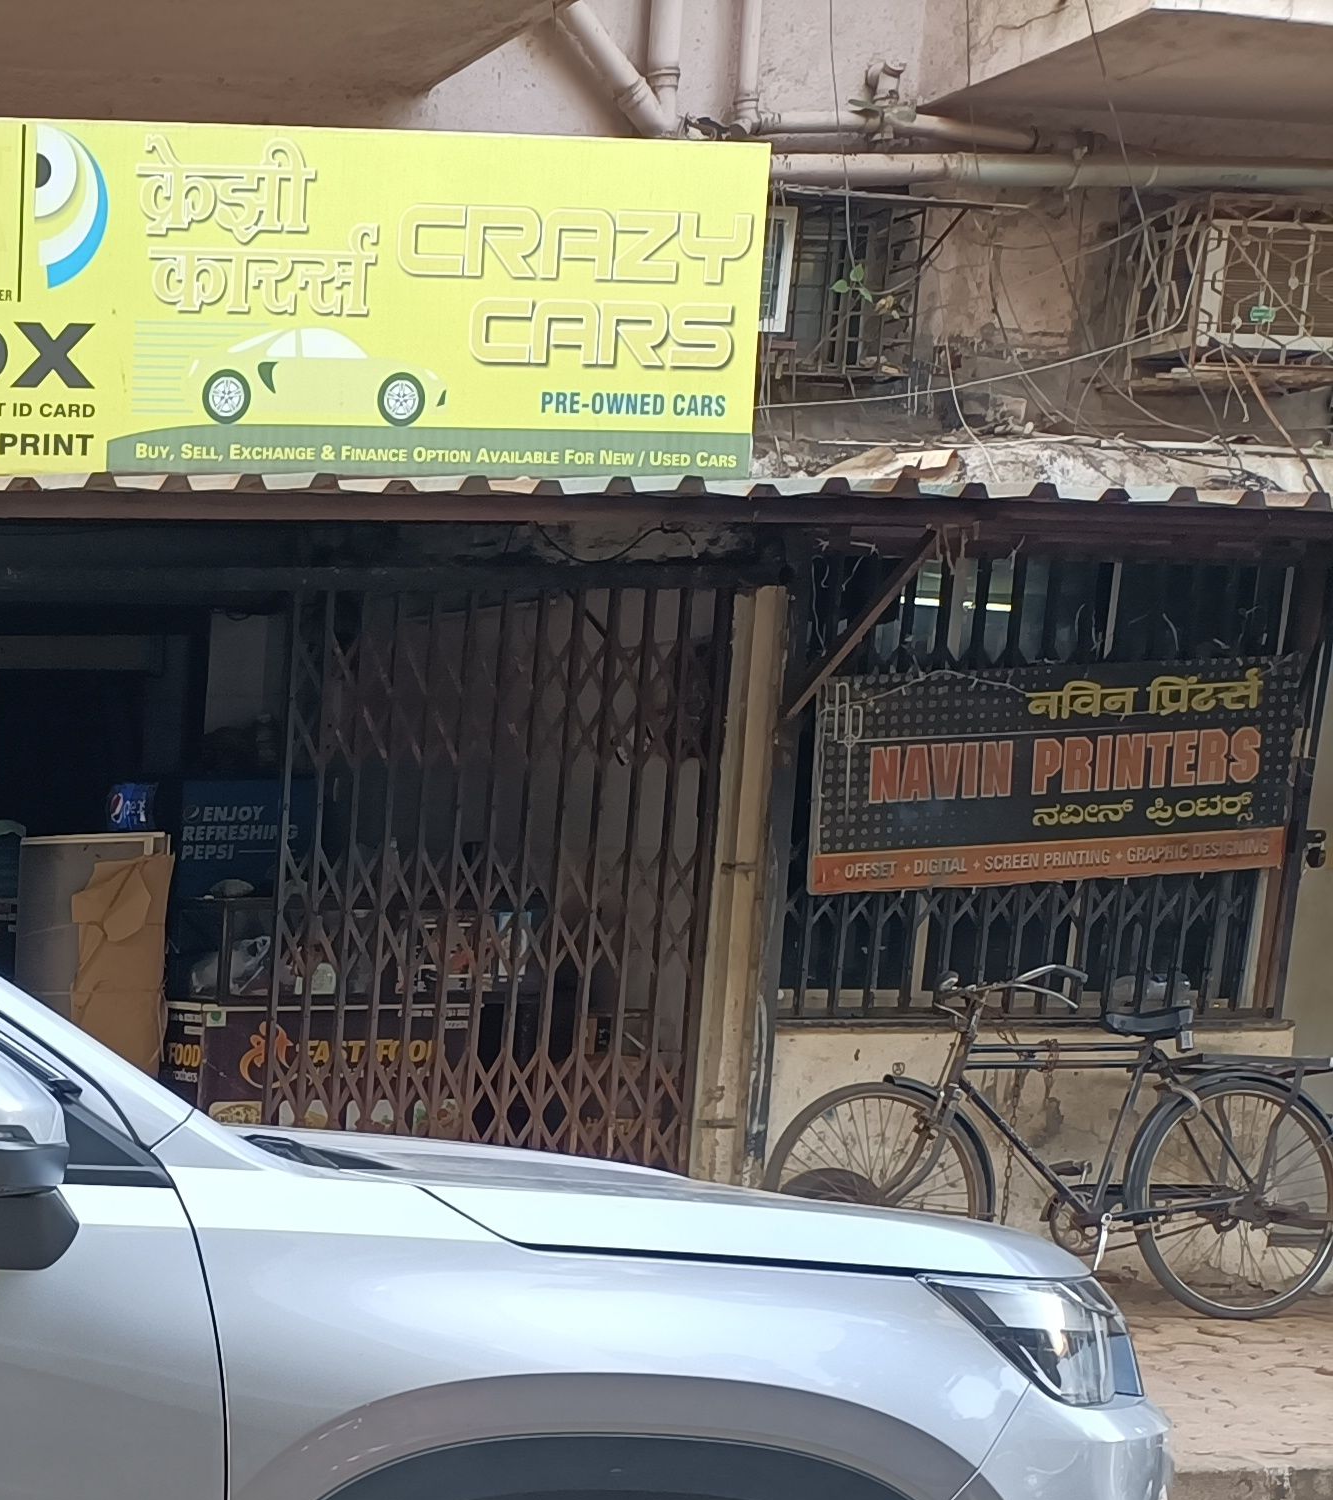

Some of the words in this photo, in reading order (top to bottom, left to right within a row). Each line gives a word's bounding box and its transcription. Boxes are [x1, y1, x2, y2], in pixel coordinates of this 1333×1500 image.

[398, 203, 754, 284] CRAZY
[469, 297, 735, 370] CARS
[13, 402, 33, 418] ID
[39, 402, 96, 419] CARD
[541, 391, 665, 416] PRE-OWNED
[672, 394, 726, 417] CARS
[321, 445, 335, 461] &
[869, 741, 1014, 804] NAVIN
[1031, 726, 1262, 796] PRINTERS
[202, 805, 267, 822] ENJOY
[181, 843, 234, 860] PEPSI
[844, 861, 898, 880] OFFSET
[914, 857, 968, 876] DIGITAL
[984, 853, 1039, 872] SCREEN
[1043, 849, 1110, 869] PRINTING
[1127, 844, 1190, 863] GRAPHIC
[1192, 838, 1269, 860] DESIGNING
[167, 1041, 201, 1067] FOOD
